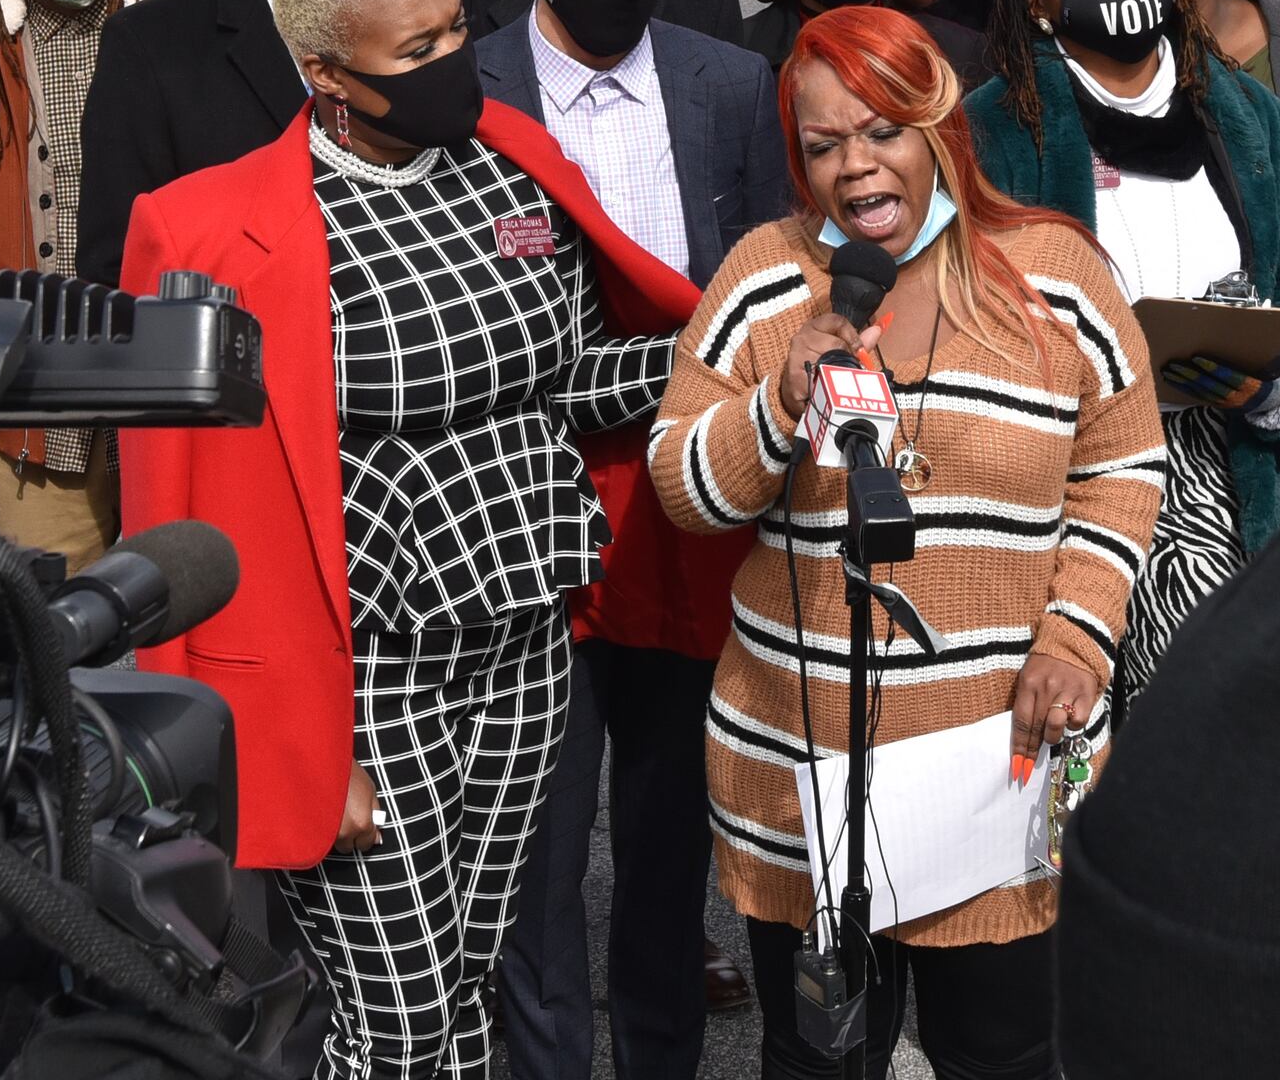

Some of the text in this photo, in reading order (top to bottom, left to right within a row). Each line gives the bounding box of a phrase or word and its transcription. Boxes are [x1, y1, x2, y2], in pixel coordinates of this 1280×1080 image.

[501, 219, 542, 229] ERICA THOMAS
[840, 397, 890, 412] ALIVE
